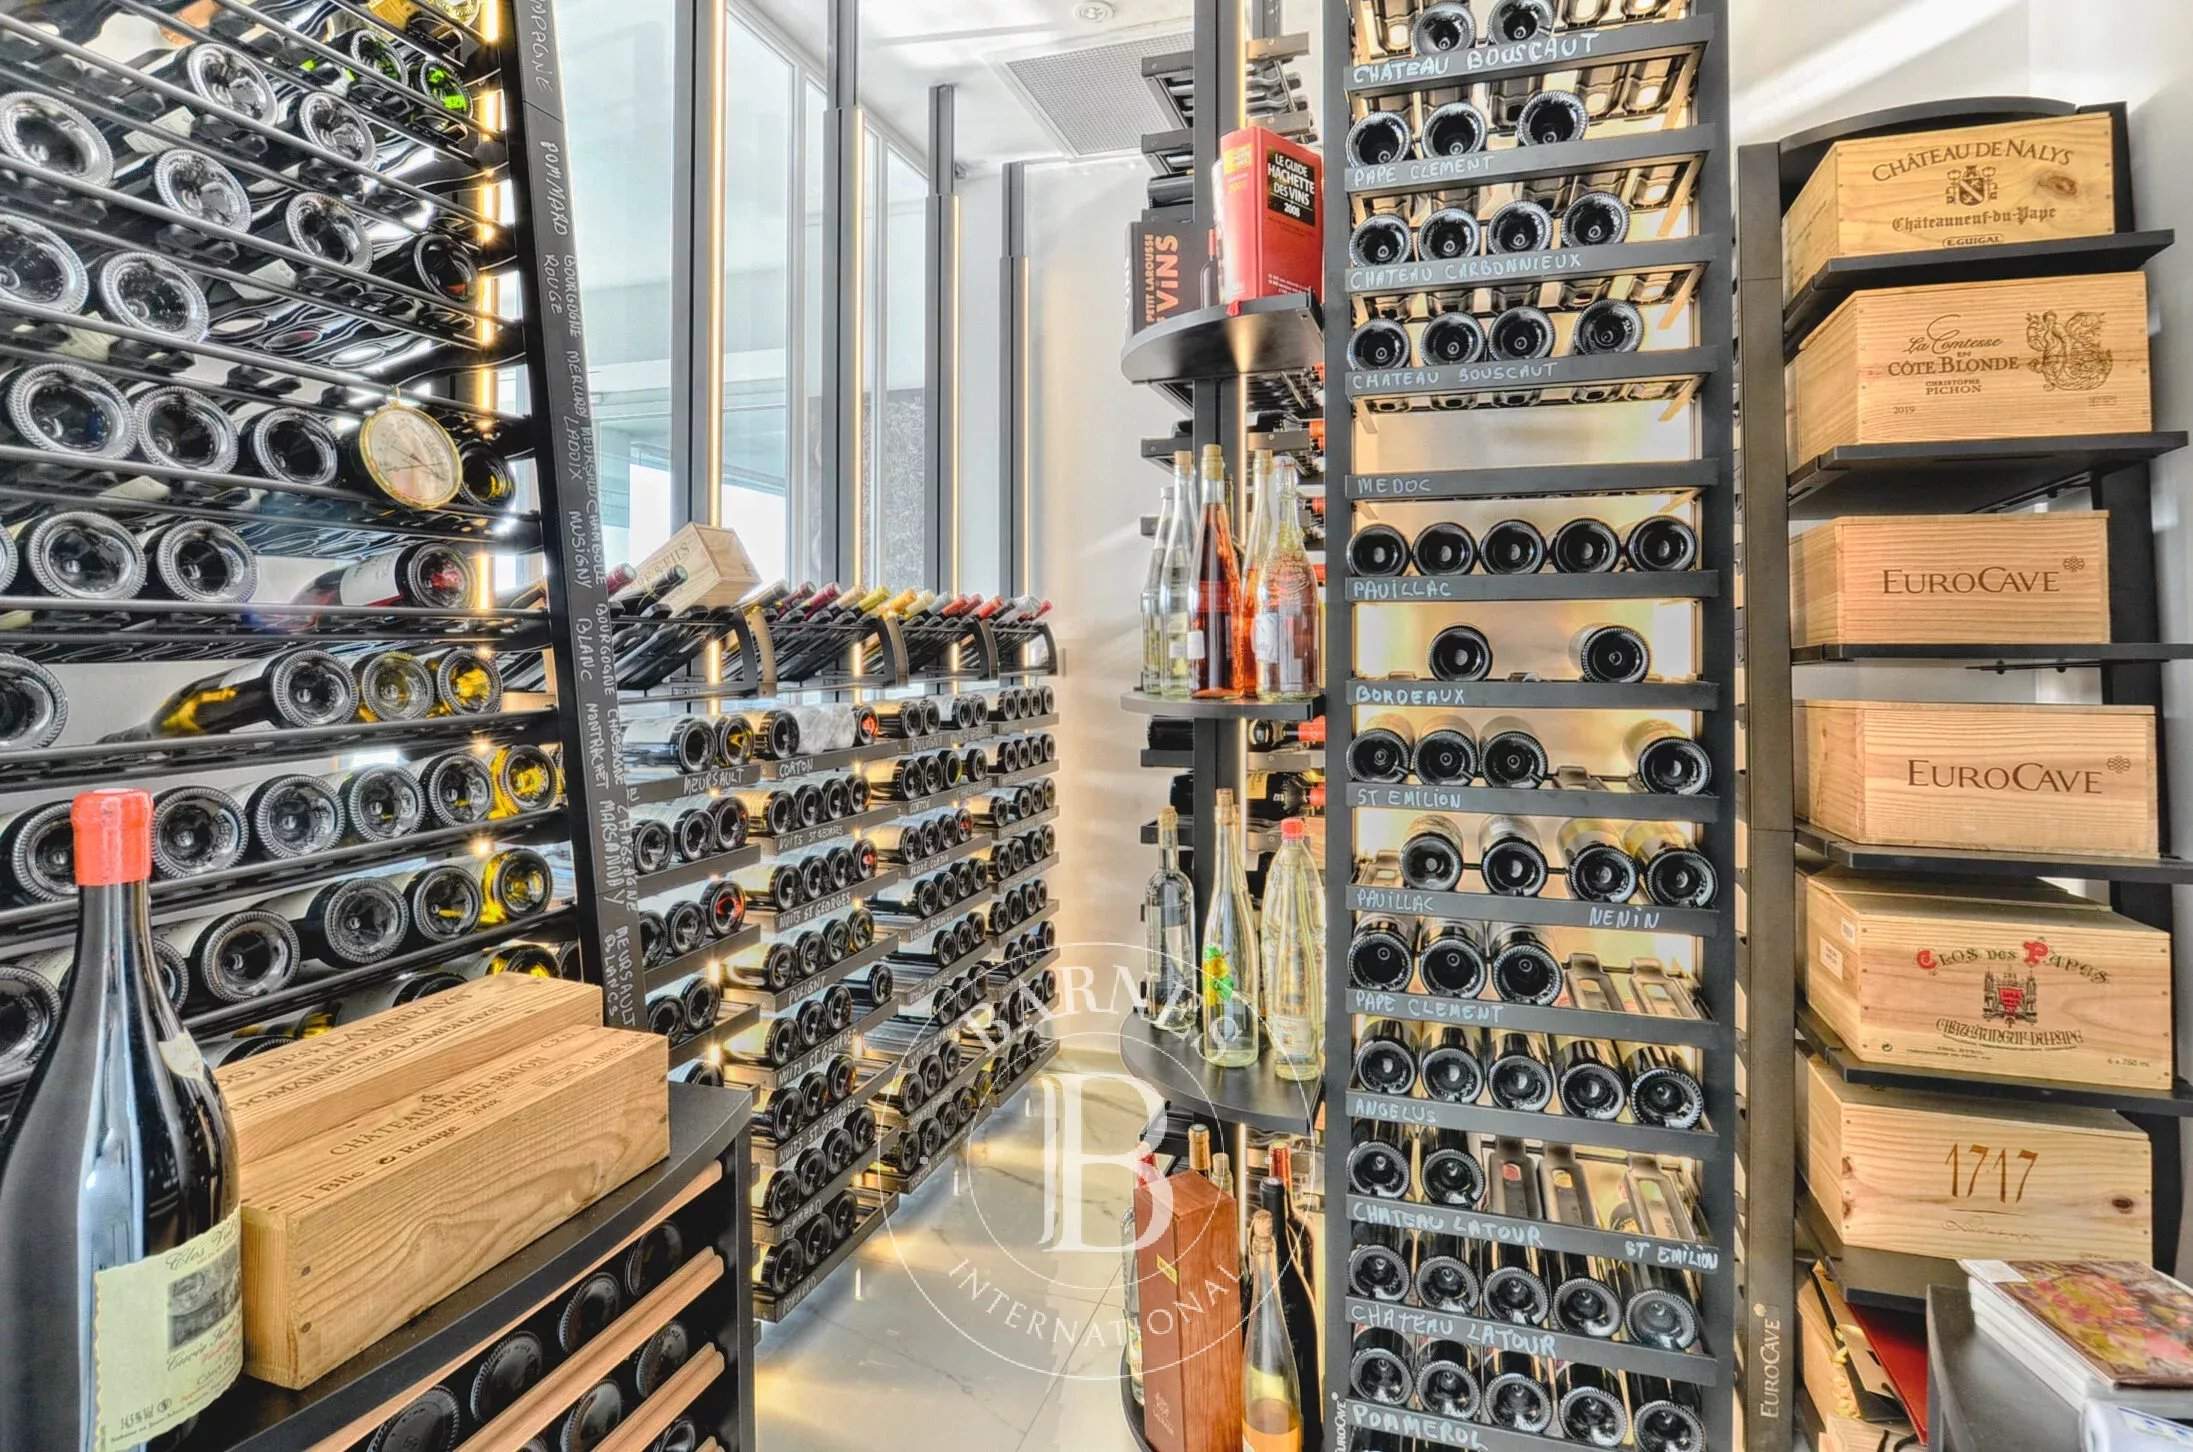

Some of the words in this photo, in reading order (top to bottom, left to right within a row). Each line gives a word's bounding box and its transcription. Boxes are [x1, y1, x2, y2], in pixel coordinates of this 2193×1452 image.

[1467, 33, 1600, 71] BOUSCAUT
[1275, 154, 1284, 167] LE
[1285, 156, 1308, 178] GUIDE
[1355, 166, 1396, 184] PAPE
[1410, 155, 1495, 179] CLEMENT
[1872, 144, 1971, 182] CHÂTEAU
[1976, 142, 2002, 158] DE
[2005, 139, 2074, 165] NALYS
[540, 141, 569, 236] POMMARD
[1267, 163, 1315, 195] HACHETTE
[1273, 183, 1288, 197] DES
[1287, 186, 1310, 206] VINS
[1144, 234, 1154, 289] LAROUSSE
[1350, 266, 1433, 289] CHATEAU
[1445, 254, 1582, 279] CARBONNIEUX
[544, 254, 562, 314] ROUGE
[1145, 292, 1154, 322] PETIT
[1352, 370, 1439, 390] CHATEAU
[1458, 362, 1557, 382] BOUSCAUT
[1888, 360, 1935, 376] CÔTE
[1939, 357, 2019, 373] BLONDE
[1926, 385, 1981, 395] PICHON
[1358, 478, 1431, 493] MEDOC
[575, 617, 595, 682] BLANC
[597, 602, 617, 697] BOURGOGNE
[1356, 685, 1465, 703] BORDEAUX
[779, 758, 814, 777] CORTON
[1357, 788, 1379, 804] ST
[615, 925, 636, 1026] MEURSAULT
[1356, 992, 1397, 1012] PAPE
[1408, 999, 1502, 1023] CLEMENT
[330, 1105, 434, 1156] CHÂTEAU
[433, 1056, 550, 1108] HAUT-BRION
[399, 1126, 461, 1154] Rouge
[1945, 1143, 2039, 1204] 1717
[1352, 1202, 1444, 1230] CHATEAU
[1454, 1217, 1545, 1247] LATOUR
[1626, 1241, 1650, 1256] ST
[1351, 1305, 1454, 1336] CHATEAU
[1467, 1323, 1557, 1357] LATOUR
